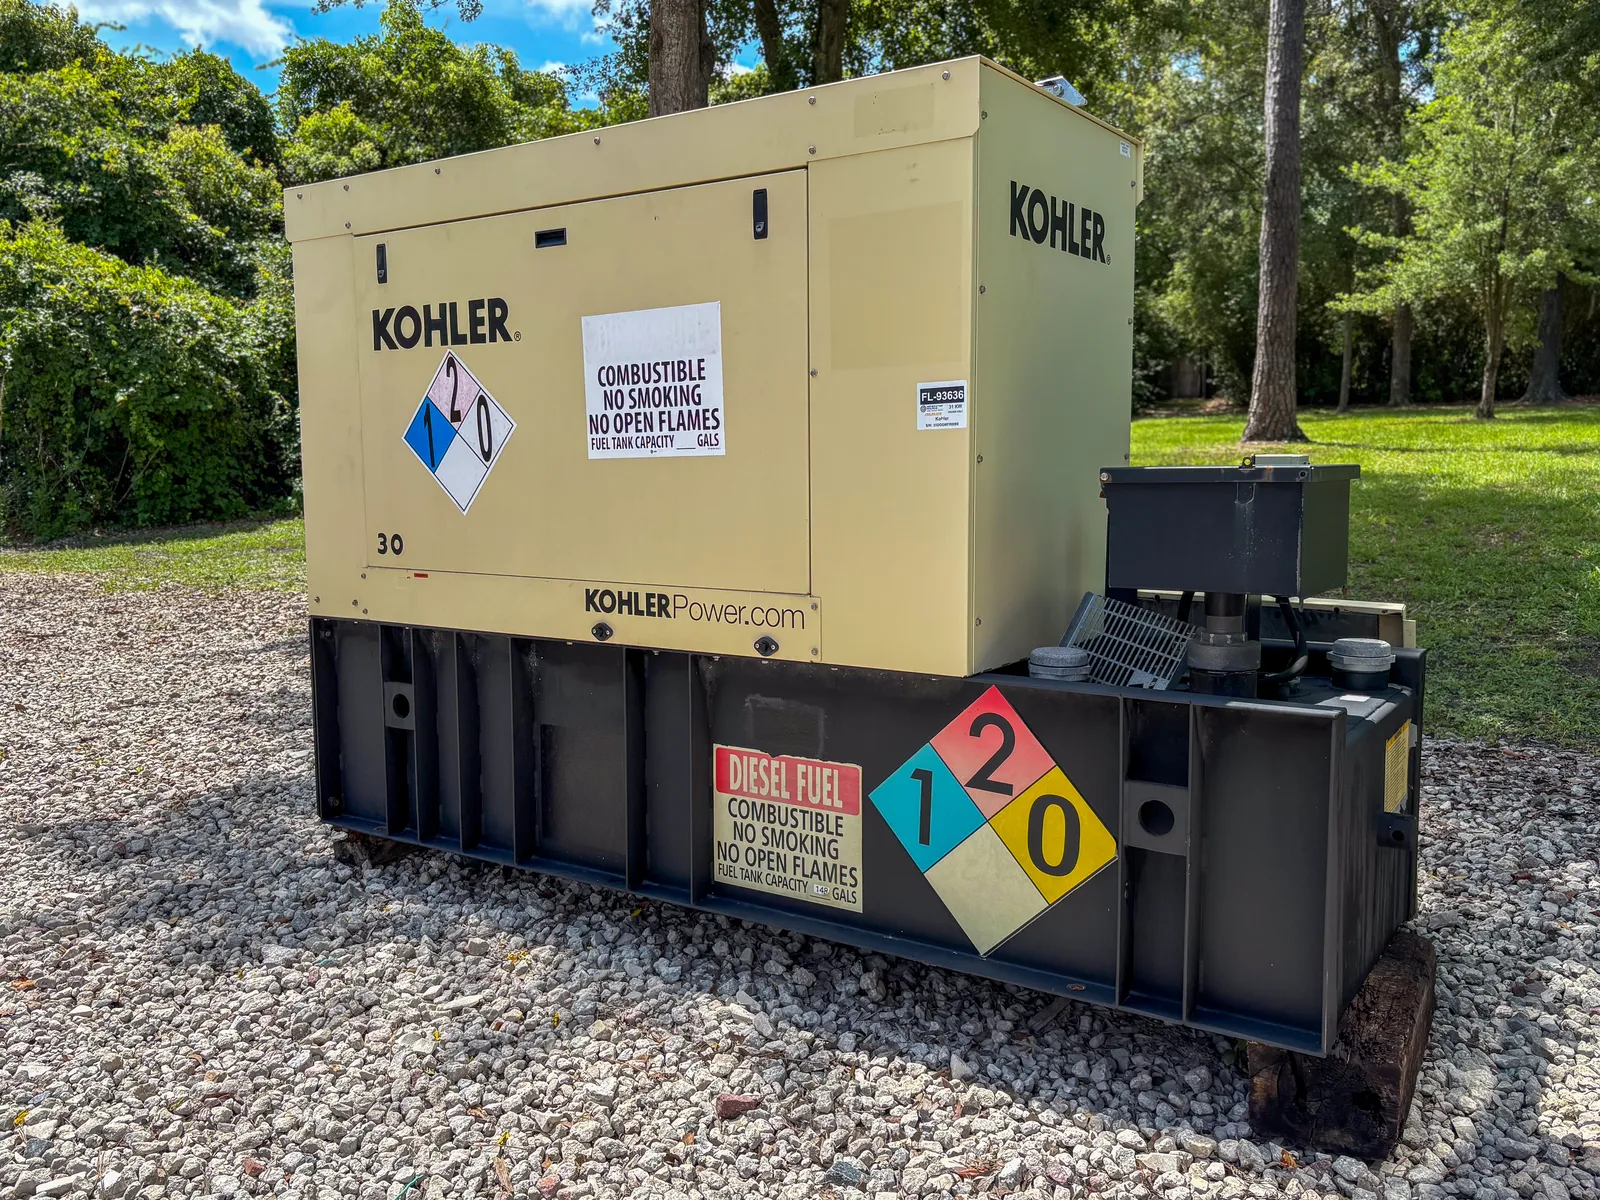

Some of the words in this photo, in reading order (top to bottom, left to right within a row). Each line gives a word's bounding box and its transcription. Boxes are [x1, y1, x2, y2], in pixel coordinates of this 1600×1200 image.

[1010, 180, 1107, 264] KOHLER
[372, 298, 513, 351] KOHLER
[446, 356, 462, 423] 2
[597, 358, 706, 387] COMBUSTIBLE
[603, 389, 625, 411] NO
[628, 383, 702, 410] SMOKING
[921, 390, 964, 402] FL-93636
[424, 403, 436, 467] 1
[477, 395, 493, 462] 0
[589, 414, 610, 435] NO
[613, 411, 654, 434] OPEN
[658, 408, 721, 432] FLAMES
[591, 437, 610, 450] FUEL
[612, 436, 634, 450] TANK
[635, 434, 675, 449] CAPACITY
[697, 433, 720, 447] GALS
[377, 533, 404, 555] 30
[585, 588, 806, 630] KOHLERPower.com
[964, 712, 1016, 797] 2
[729, 753, 790, 800] DIESEL
[796, 763, 843, 809] FUEL
[727, 797, 844, 837] COMBUSTIBLE
[909, 767, 933, 847] 1
[1027, 794, 1081, 877] 0
[733, 821, 756, 844] NO
[761, 825, 839, 860] SMOKING
[717, 841, 740, 863] NO
[745, 846, 787, 874] OPEN
[793, 855, 858, 888] FLAMES
[718, 863, 738, 879] FUEL
[740, 867, 763, 884] TANK
[765, 873, 809, 894] CAPACITY
[815, 885, 829, 894] 148
[832, 887, 857, 904] GALS
